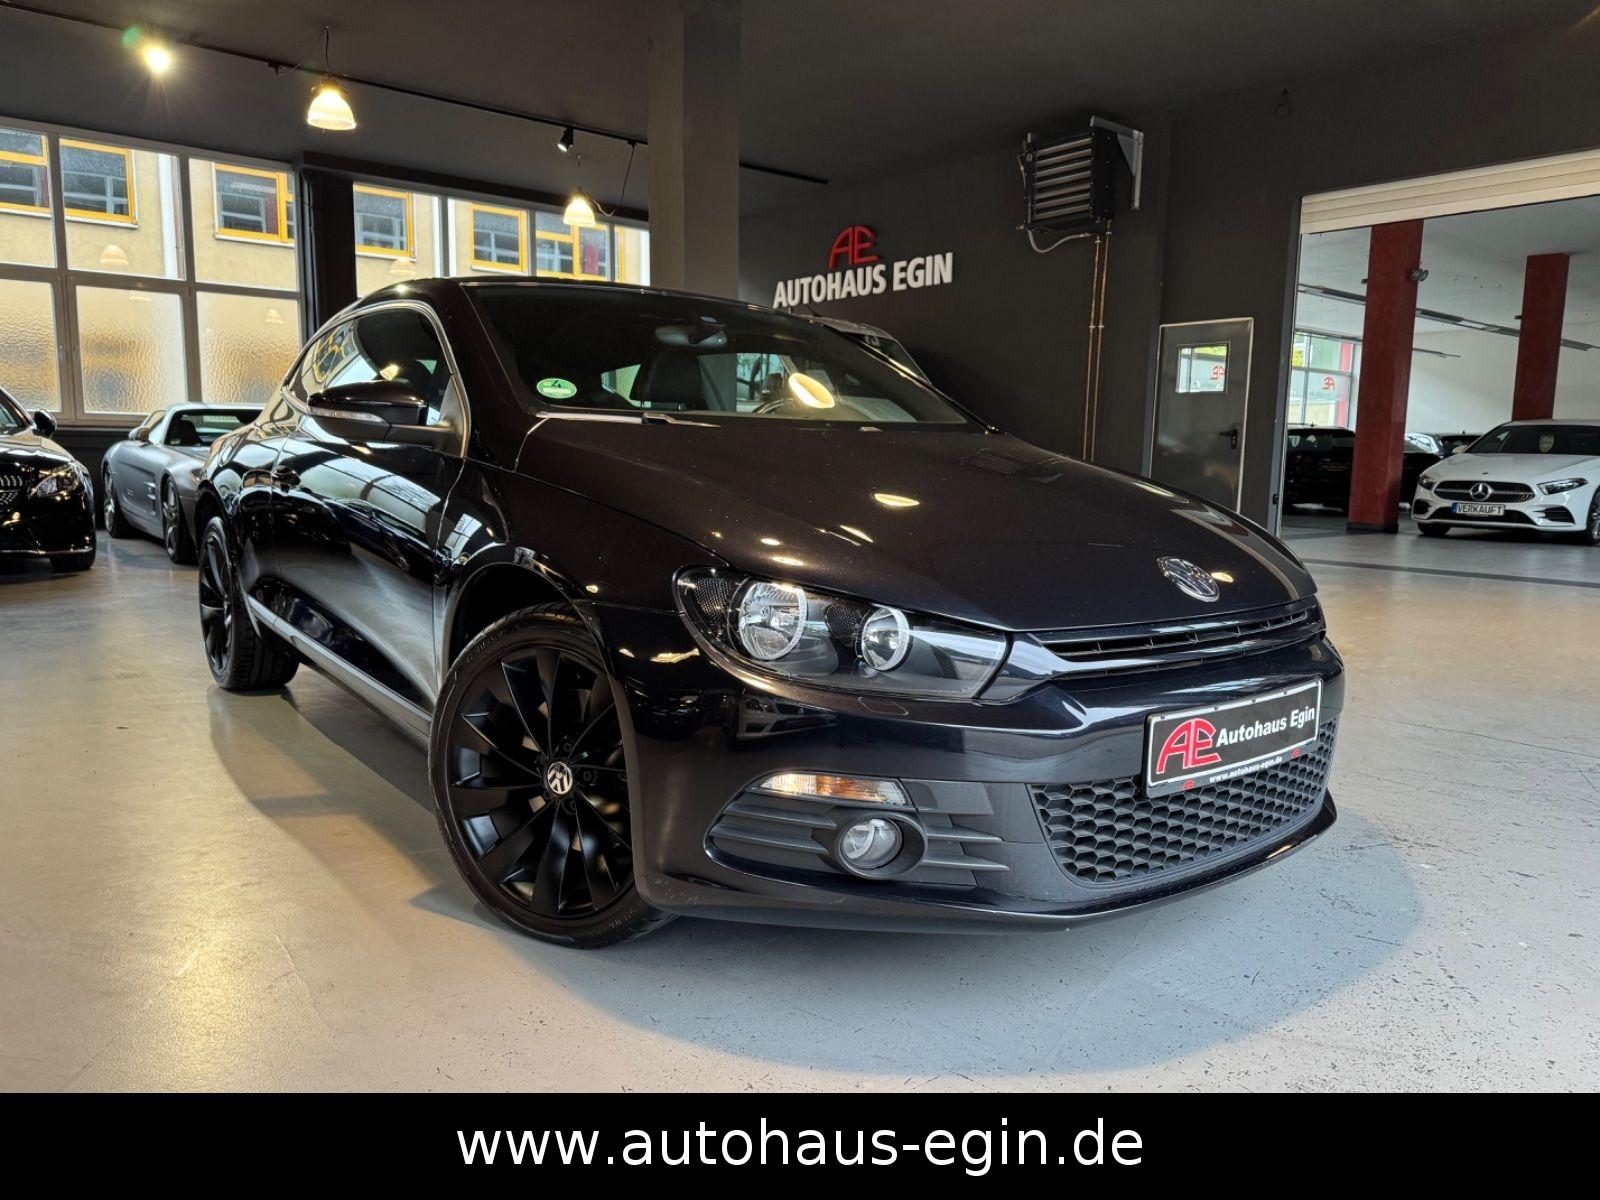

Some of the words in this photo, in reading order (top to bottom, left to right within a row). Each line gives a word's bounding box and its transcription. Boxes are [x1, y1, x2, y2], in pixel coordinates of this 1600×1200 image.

[772, 264, 888, 309] AUTOHAUS
[892, 252, 954, 292] EGIN
[1457, 502, 1503, 515] VERKAUFT
[1215, 717, 1287, 748] Autohaus
[1289, 705, 1316, 729] Egin
